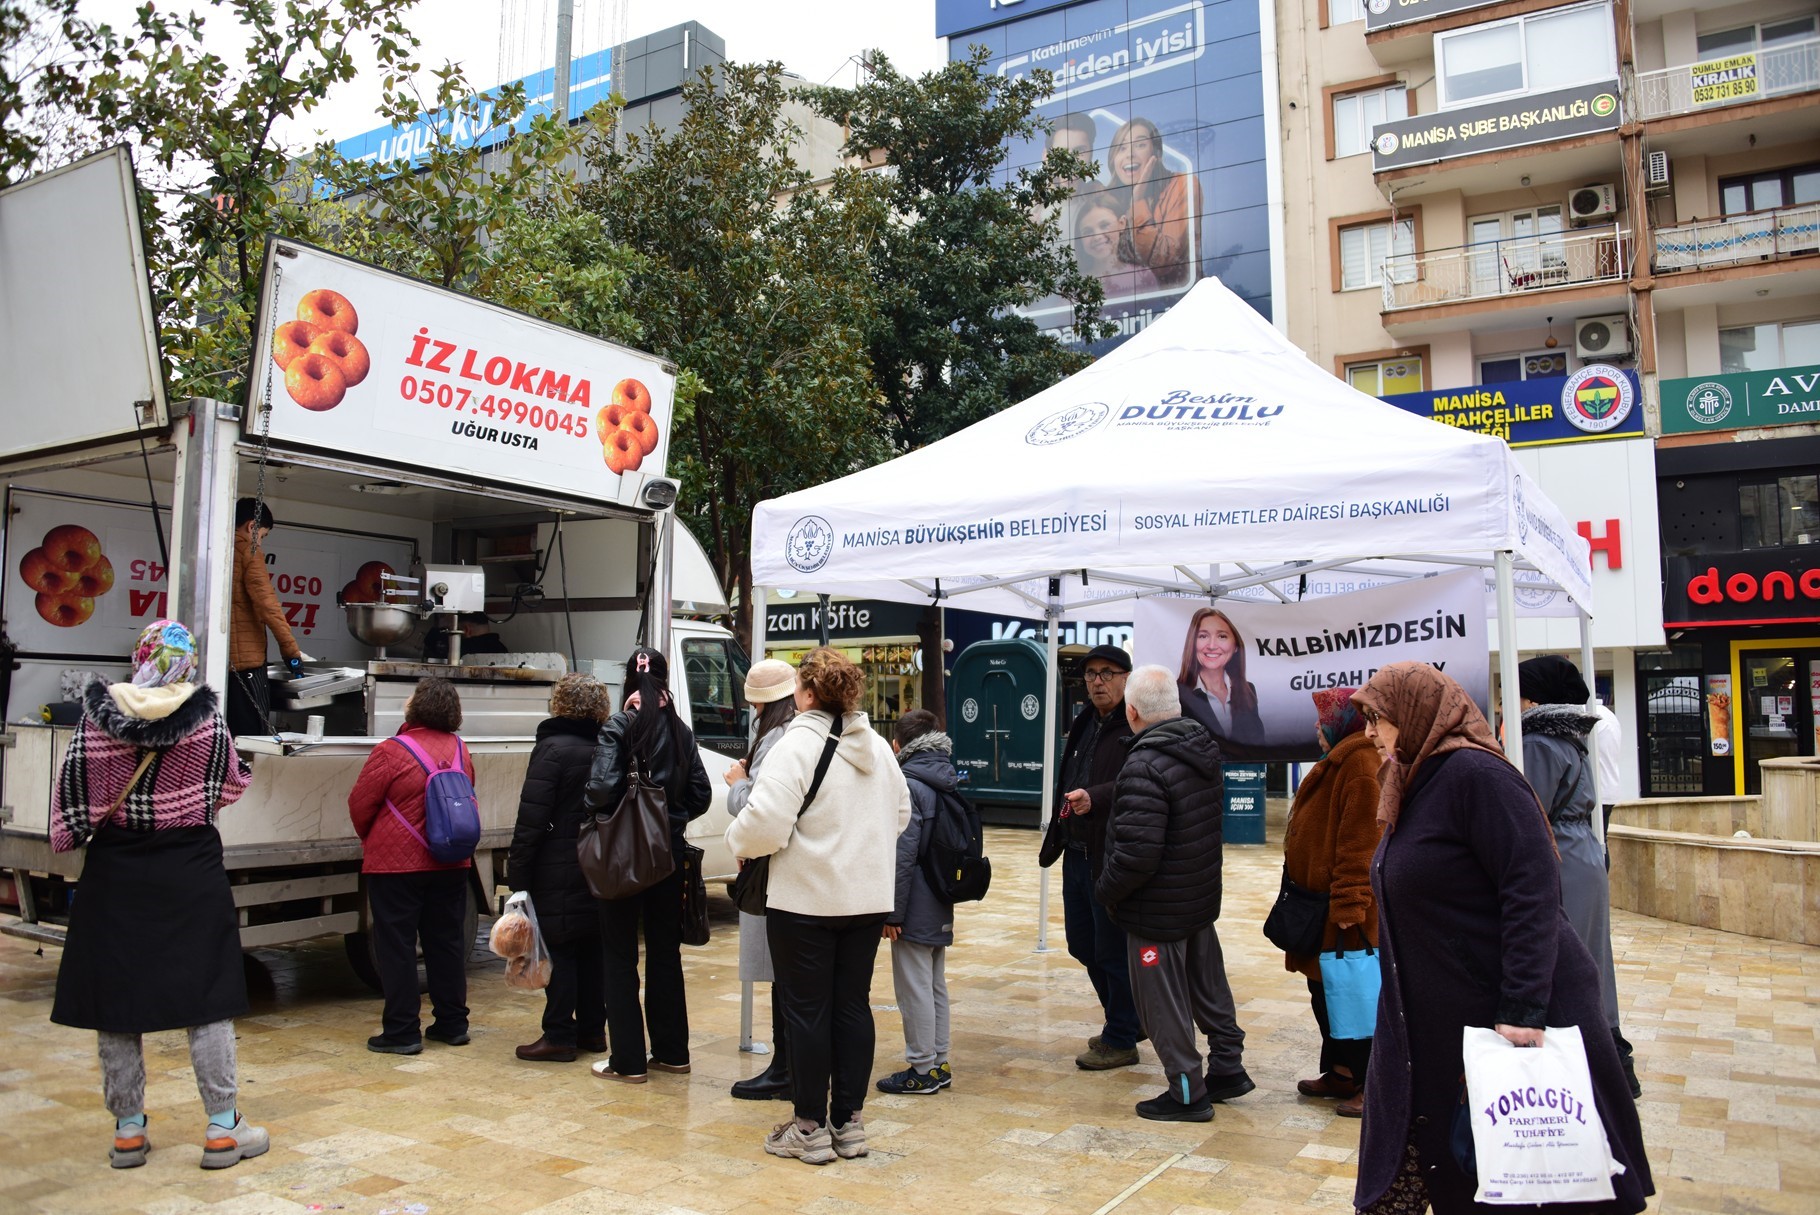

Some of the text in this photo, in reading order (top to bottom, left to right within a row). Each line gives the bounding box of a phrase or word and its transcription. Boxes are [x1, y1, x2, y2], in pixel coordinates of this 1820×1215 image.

[1135, 22, 1193, 67] iyisi
[1692, 56, 1754, 75] DUMLU EMLAK
[1694, 79, 1756, 103] 0532 731 85 90
[1402, 99, 1589, 149] MANİSA ŞUBE BAŞKANLIĞI
[405, 327, 591, 408] İZ LOKMA
[1595, 367, 1620, 381] SPOR
[400, 375, 588, 438] 0507.4990045
[1161, 389, 1258, 405] Besim
[1433, 390, 1506, 412] MANİSA
[1119, 404, 1285, 421] DUTLULU
[1589, 420, 1608, 429] 1907
[451, 420, 539, 451] UĞUR USTA
[1134, 492, 1450, 531] SOSYAL HİZMETLER DAİRESİ BAŞKANLIĞI
[842, 510, 1107, 549] MANİSA BÜYÜKŞEHİR BELEDİYESİ
[1255, 609, 1467, 657] KALBİMİZDESİN
[716, 742, 746, 750] TRANSIT
[1508, 1114, 1569, 1126] PARMERİ
